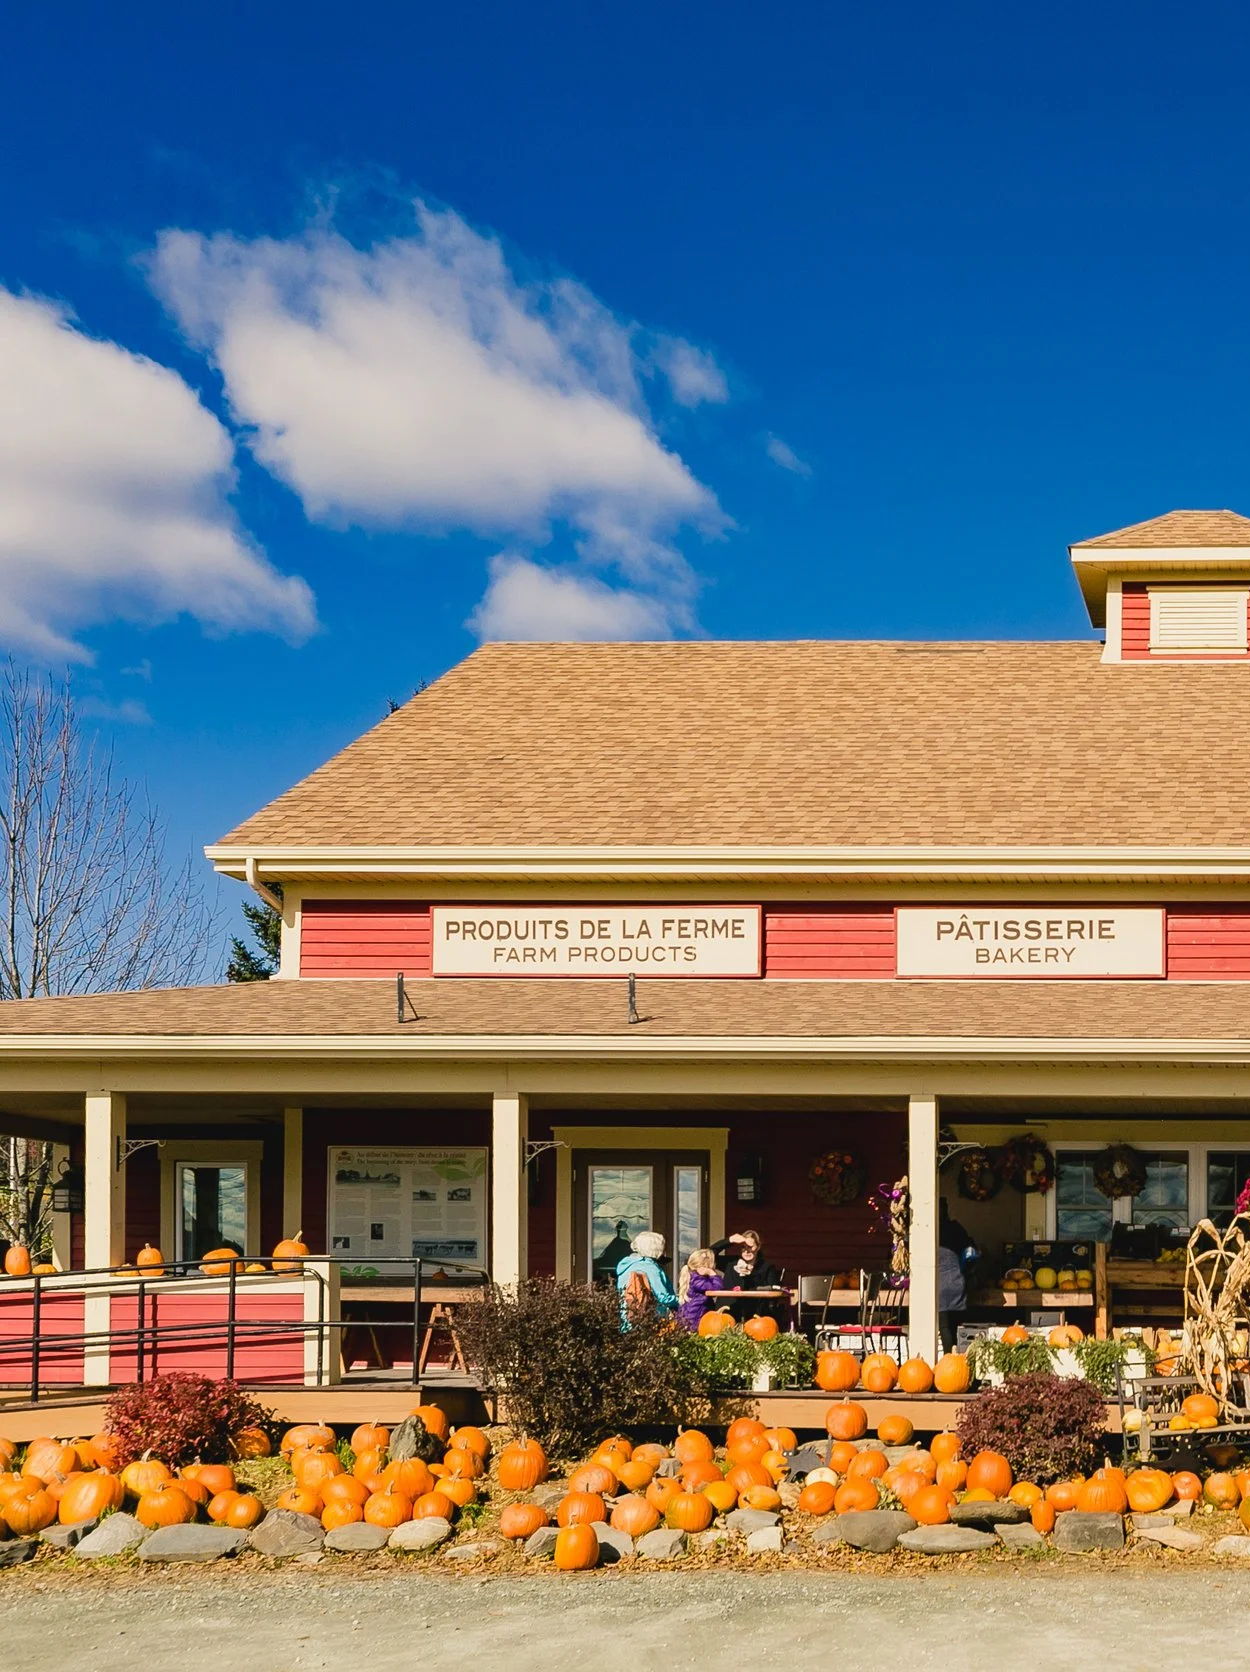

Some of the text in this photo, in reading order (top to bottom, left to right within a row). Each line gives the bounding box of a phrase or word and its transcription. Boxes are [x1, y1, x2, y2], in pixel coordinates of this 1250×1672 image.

[445, 918, 745, 941] PRODUITS DE LA FERME
[936, 914, 1116, 941] PÂTISSERIE
[493, 946, 698, 963] FARM PRODUCTS
[975, 947, 1076, 964] BAKERY
